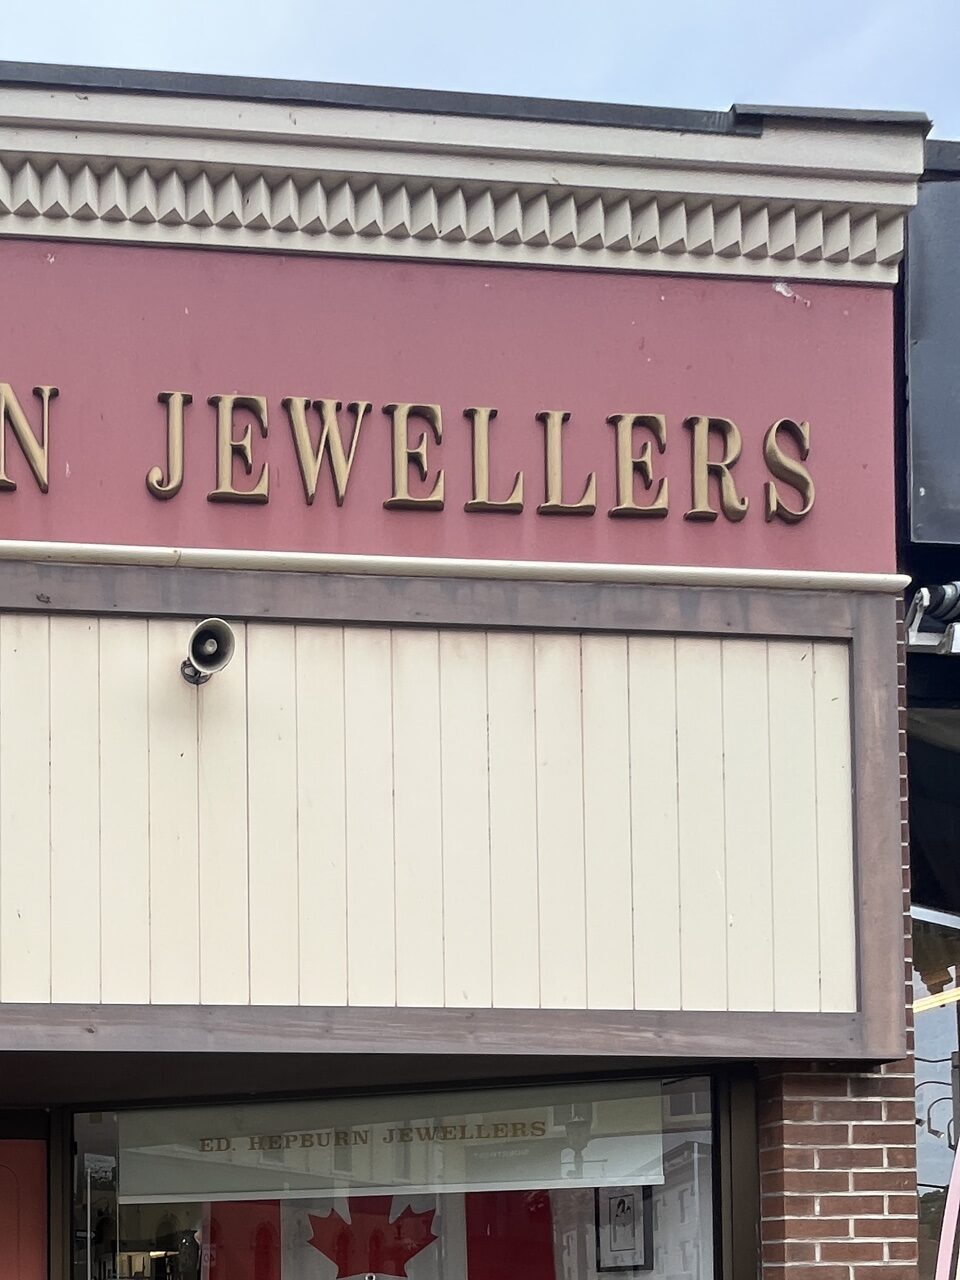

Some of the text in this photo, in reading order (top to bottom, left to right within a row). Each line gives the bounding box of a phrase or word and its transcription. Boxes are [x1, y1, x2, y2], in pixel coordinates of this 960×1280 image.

[145, 390, 817, 524] JEWELLERS
[198, 1120, 547, 1153] ED. HEPBURN JEWELLERS
